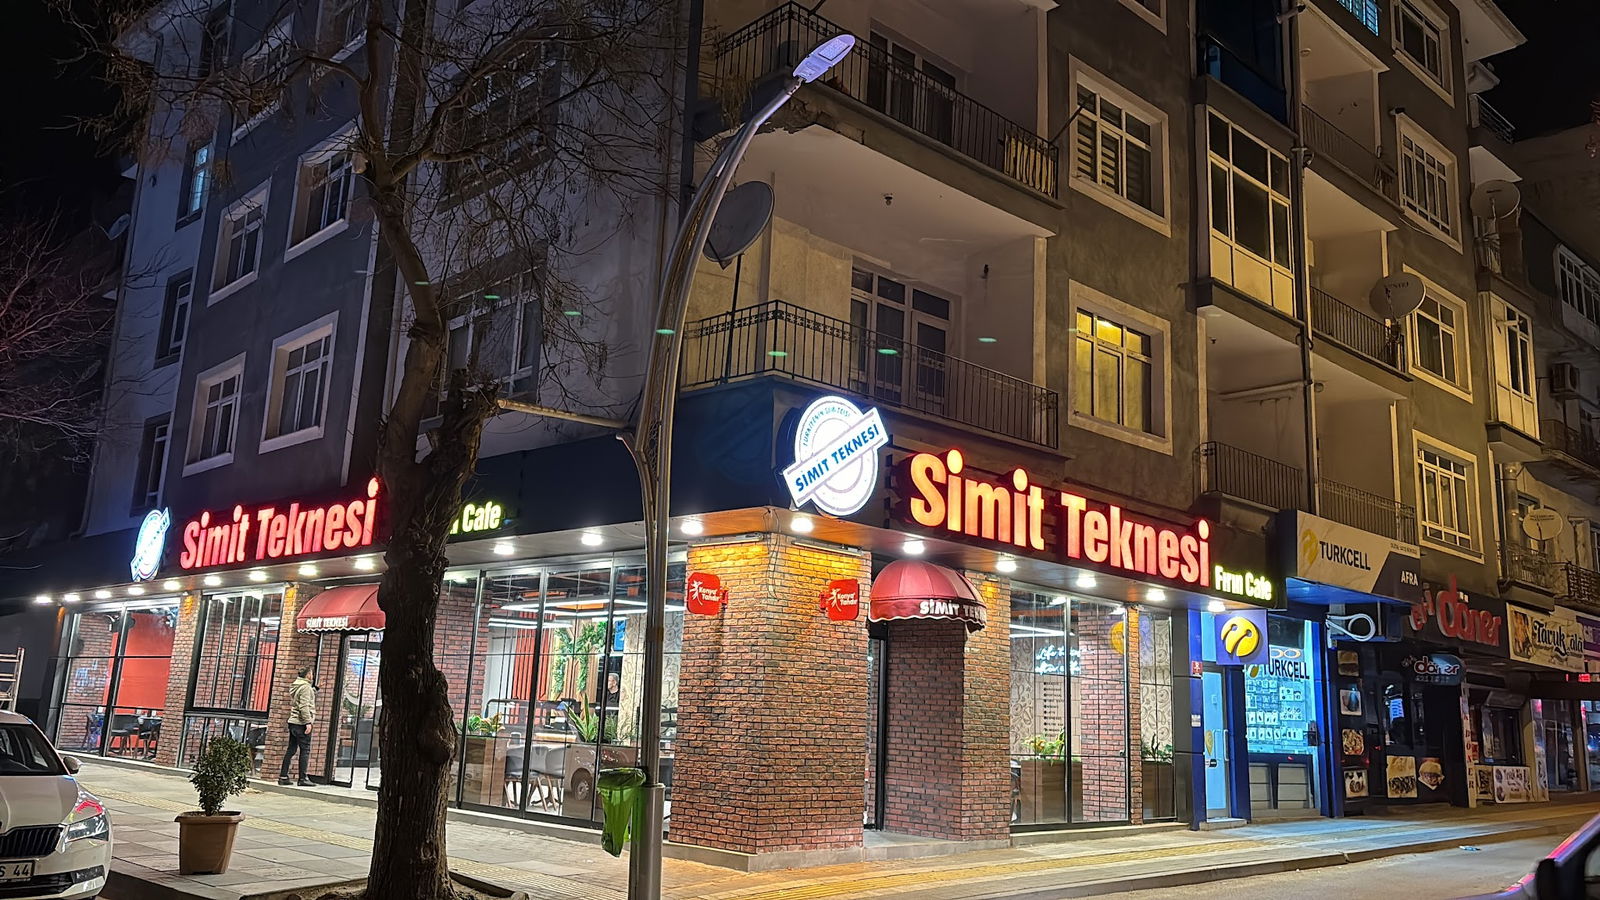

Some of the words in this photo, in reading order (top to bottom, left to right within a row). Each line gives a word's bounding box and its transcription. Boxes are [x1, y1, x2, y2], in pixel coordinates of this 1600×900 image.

[180, 504, 250, 569] Simit
[255, 477, 379, 560] Teknesi
[462, 501, 501, 532] Cafe
[910, 449, 1045, 551] Simit
[1060, 491, 1210, 587] Teknesi
[1319, 541, 1371, 571] TURKCELL
[1245, 572, 1272, 601] Cafe
[1401, 570, 1419, 587] AFRA
[13, 864, 29, 876] 44
